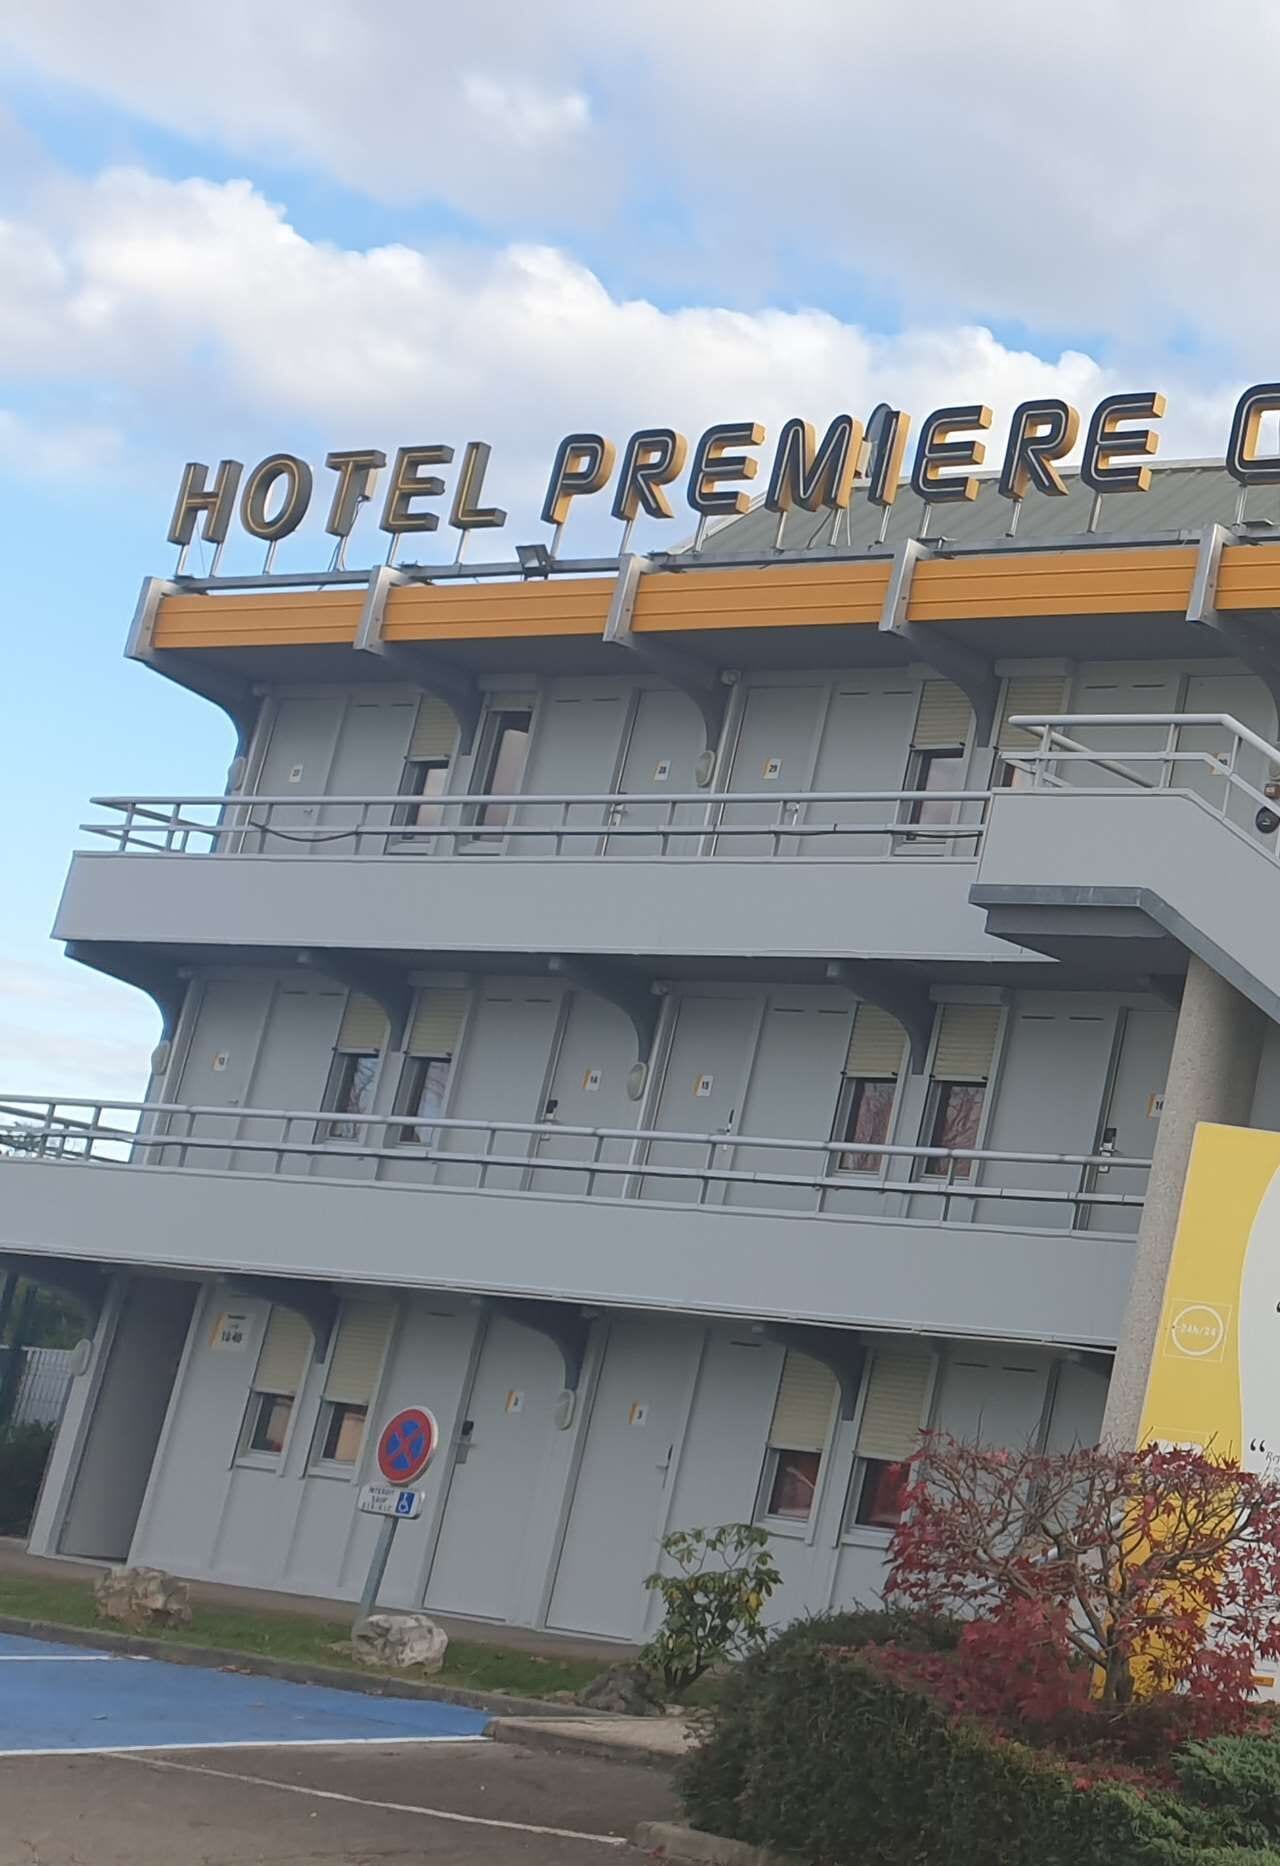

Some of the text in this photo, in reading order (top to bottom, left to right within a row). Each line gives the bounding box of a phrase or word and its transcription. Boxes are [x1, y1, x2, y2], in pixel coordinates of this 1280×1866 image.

[167, 441, 507, 545] HOTEL
[540, 391, 1166, 525] PREMIERE
[769, 764, 778, 773] 29
